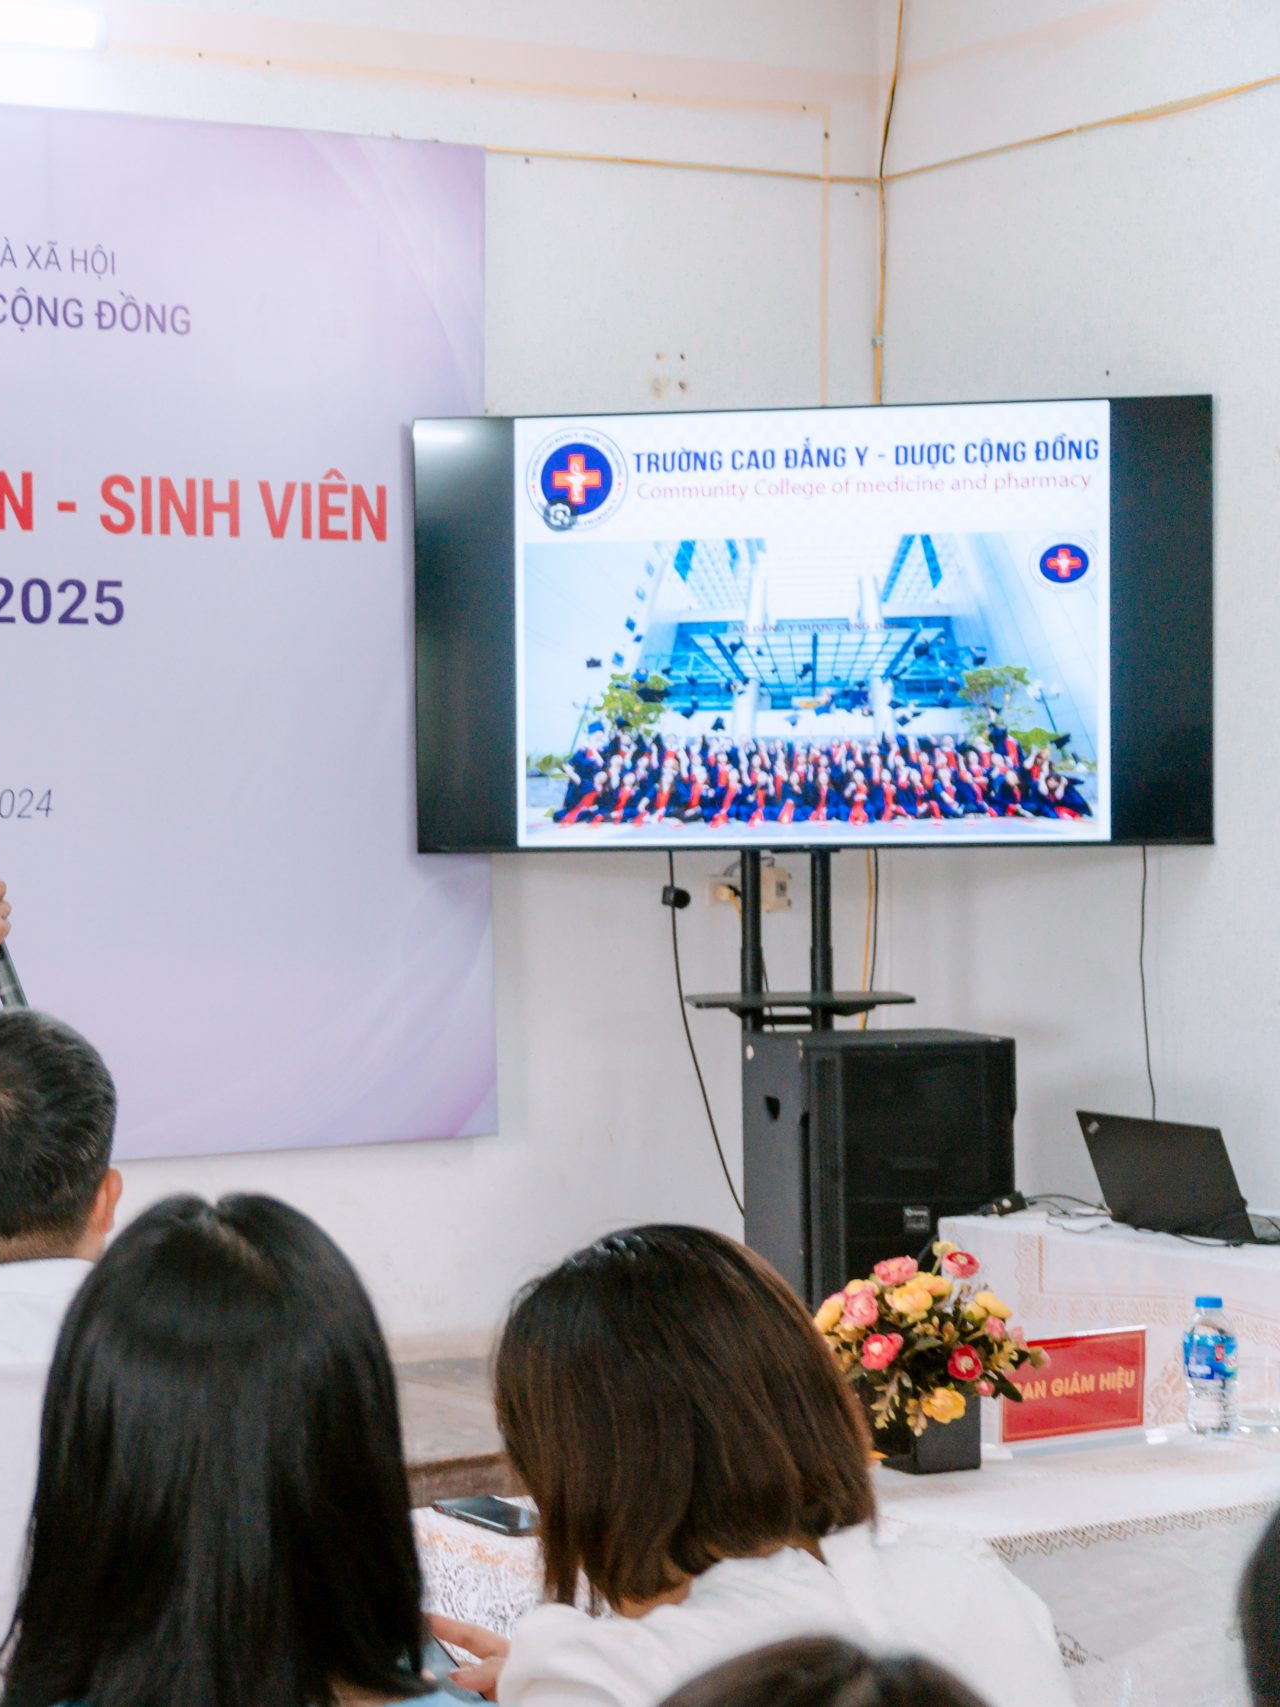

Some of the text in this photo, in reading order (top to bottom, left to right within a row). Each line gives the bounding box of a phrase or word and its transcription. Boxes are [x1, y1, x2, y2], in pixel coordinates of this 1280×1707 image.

[26, 241, 62, 272] XÃ
[71, 243, 116, 280] HỘI
[94, 291, 192, 336] ĐỒNG
[632, 447, 723, 474] TRƯỜNG
[731, 448, 776, 471] CAO
[783, 436, 847, 470] ĐẲNG
[854, 446, 869, 467] Y
[894, 442, 956, 470] DƯỢC
[963, 437, 1027, 468] CỘNG
[1034, 433, 1099, 462] ĐỒNG
[56, 500, 77, 513] -
[99, 474, 240, 538] SINH
[258, 468, 388, 542] VIÊN
[637, 471, 1092, 500] Community College of medicine and pharmacy
[1051, 1371, 1095, 1397] GIÁM
